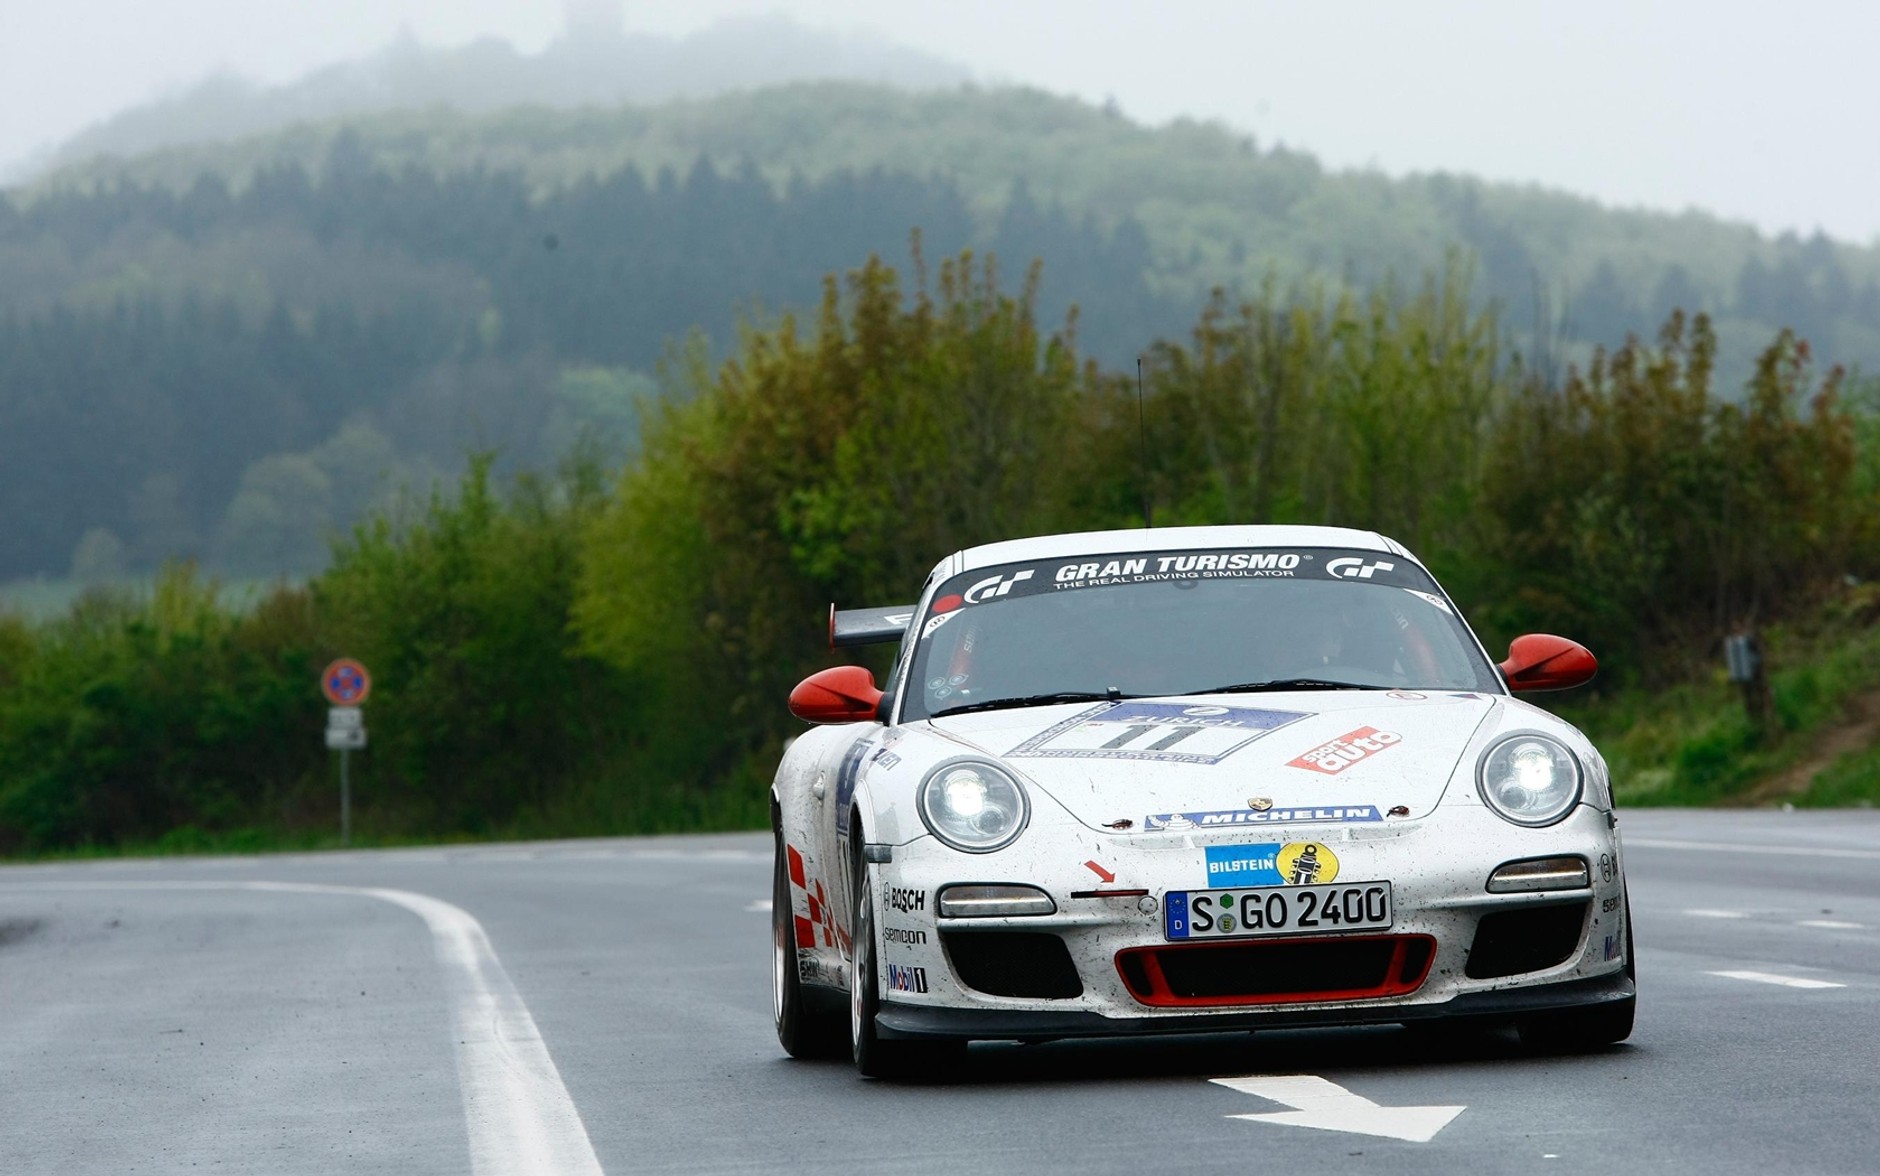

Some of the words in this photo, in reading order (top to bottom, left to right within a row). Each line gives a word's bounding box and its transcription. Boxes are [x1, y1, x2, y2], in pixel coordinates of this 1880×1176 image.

[1054, 558, 1148, 583] GRAN
[1156, 553, 1301, 573] TURISMO
[1053, 581, 1088, 590] THE
[1089, 576, 1131, 586] REAL
[1134, 571, 1199, 582] DRIVING
[1203, 570, 1294, 578] SIMULATOR
[1098, 724, 1206, 751] 11
[1302, 739, 1347, 763] sport
[1316, 731, 1403, 771] auto
[1201, 808, 1371, 824] MICHELIN
[1209, 859, 1274, 873] BILSTEIN
[892, 888, 926, 911] BOSCH
[1191, 895, 1214, 931] S
[1240, 892, 1288, 930] GO
[1296, 887, 1387, 926] 2400
[884, 927, 927, 944] semcon
[1174, 919, 1183, 930] D
[889, 964, 914, 993] Mobil
